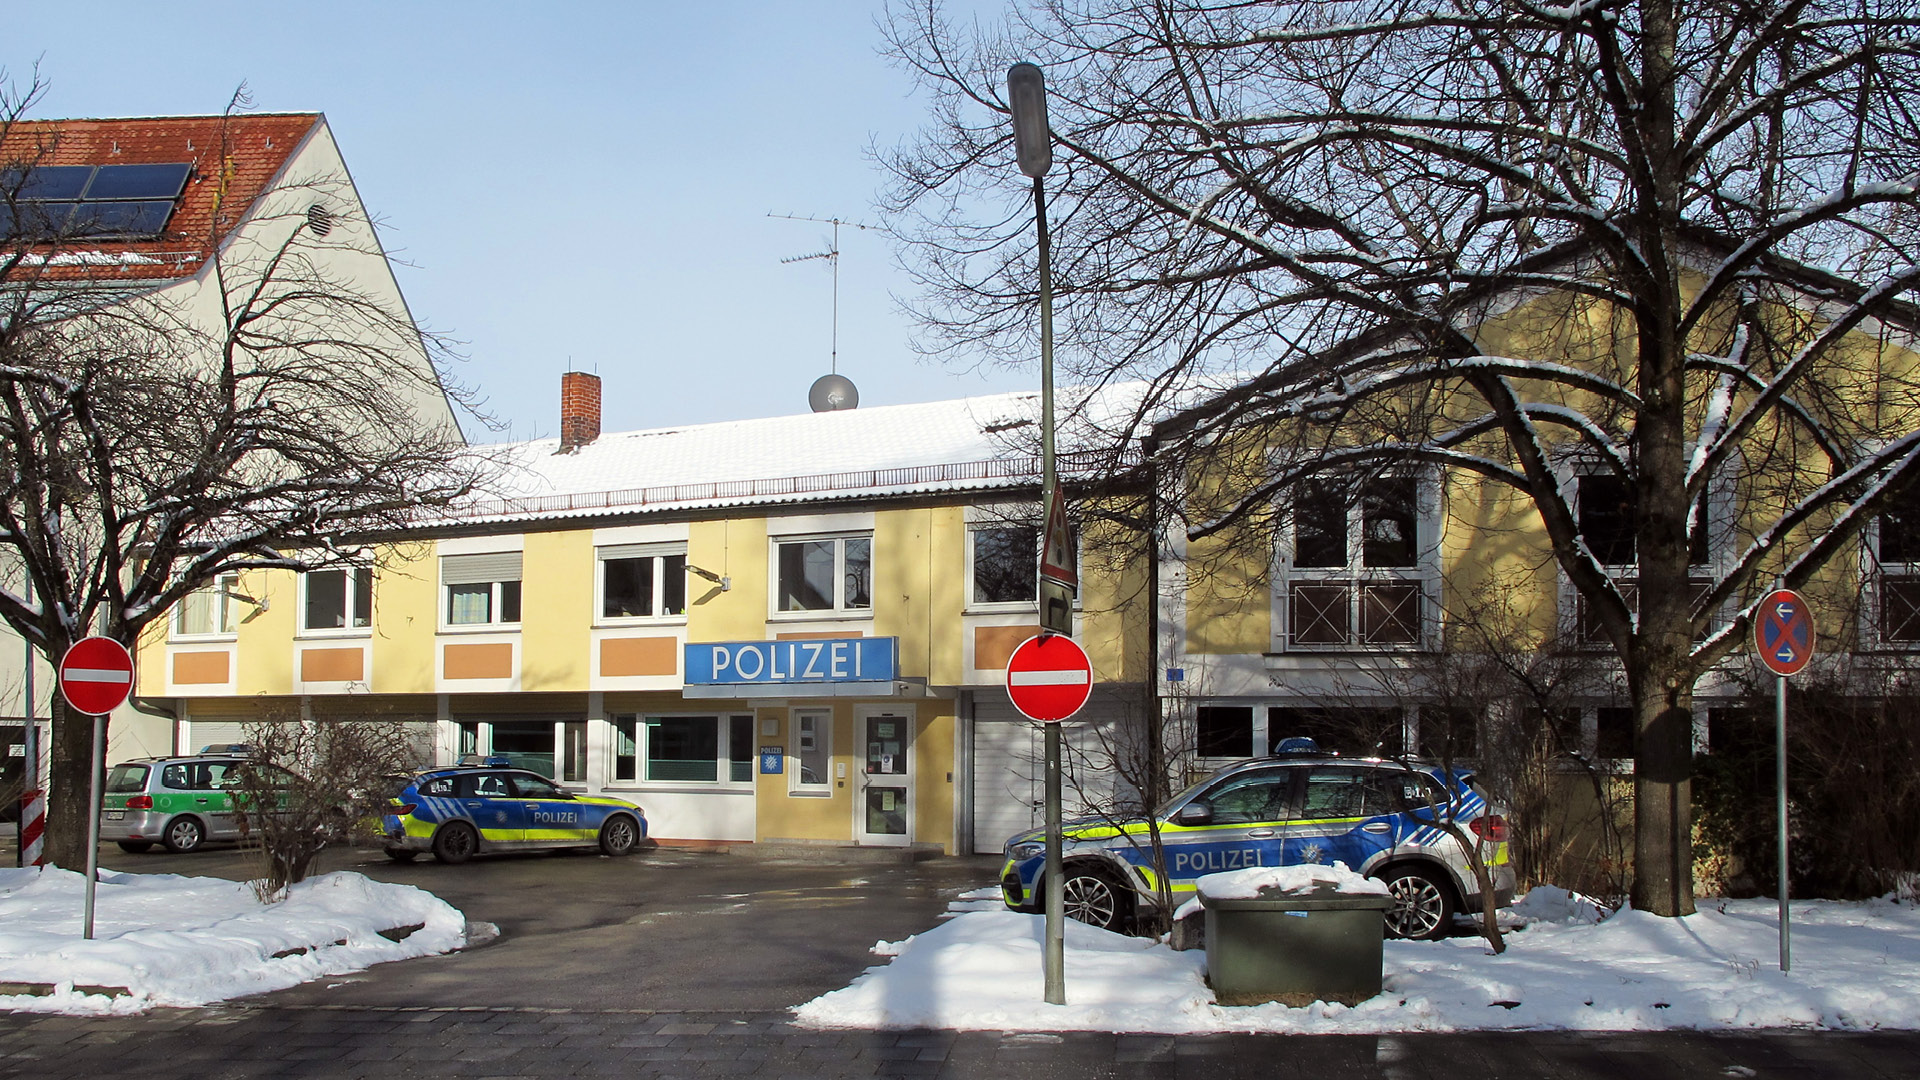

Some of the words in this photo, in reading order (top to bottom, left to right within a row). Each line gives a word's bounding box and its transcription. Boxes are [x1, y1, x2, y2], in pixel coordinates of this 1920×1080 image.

[712, 642, 861, 679] POLIZEI
[534, 811, 578, 824] POLIZEI
[1175, 848, 1262, 871] POLIZEI
